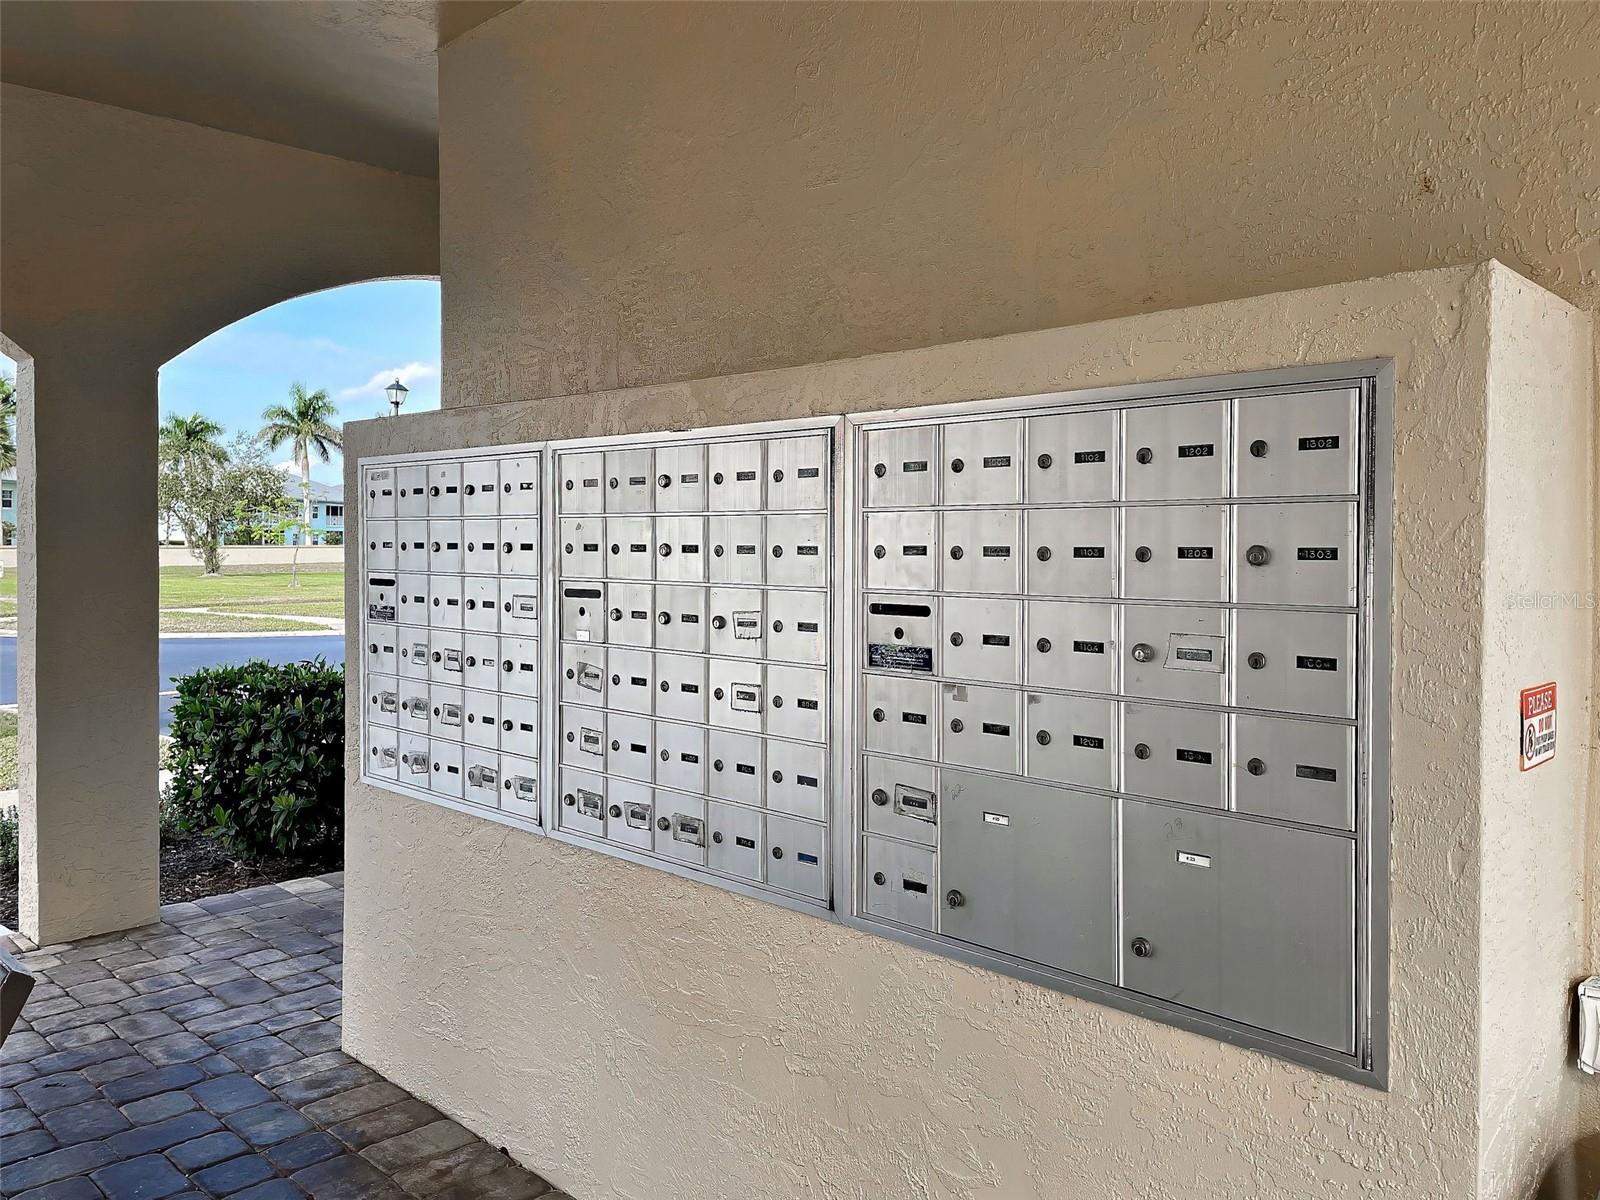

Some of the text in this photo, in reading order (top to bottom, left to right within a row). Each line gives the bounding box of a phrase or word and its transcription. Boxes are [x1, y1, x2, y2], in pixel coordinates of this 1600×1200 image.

[1305, 439, 1333, 449] 1302
[1184, 446, 1208, 456] 1202
[1080, 453, 1100, 462] 1102
[1079, 548, 1100, 557] 1103
[1183, 548, 1208, 558] 1203
[1304, 549, 1332, 559] 1303
[1527, 690, 1553, 716] PLEASE
